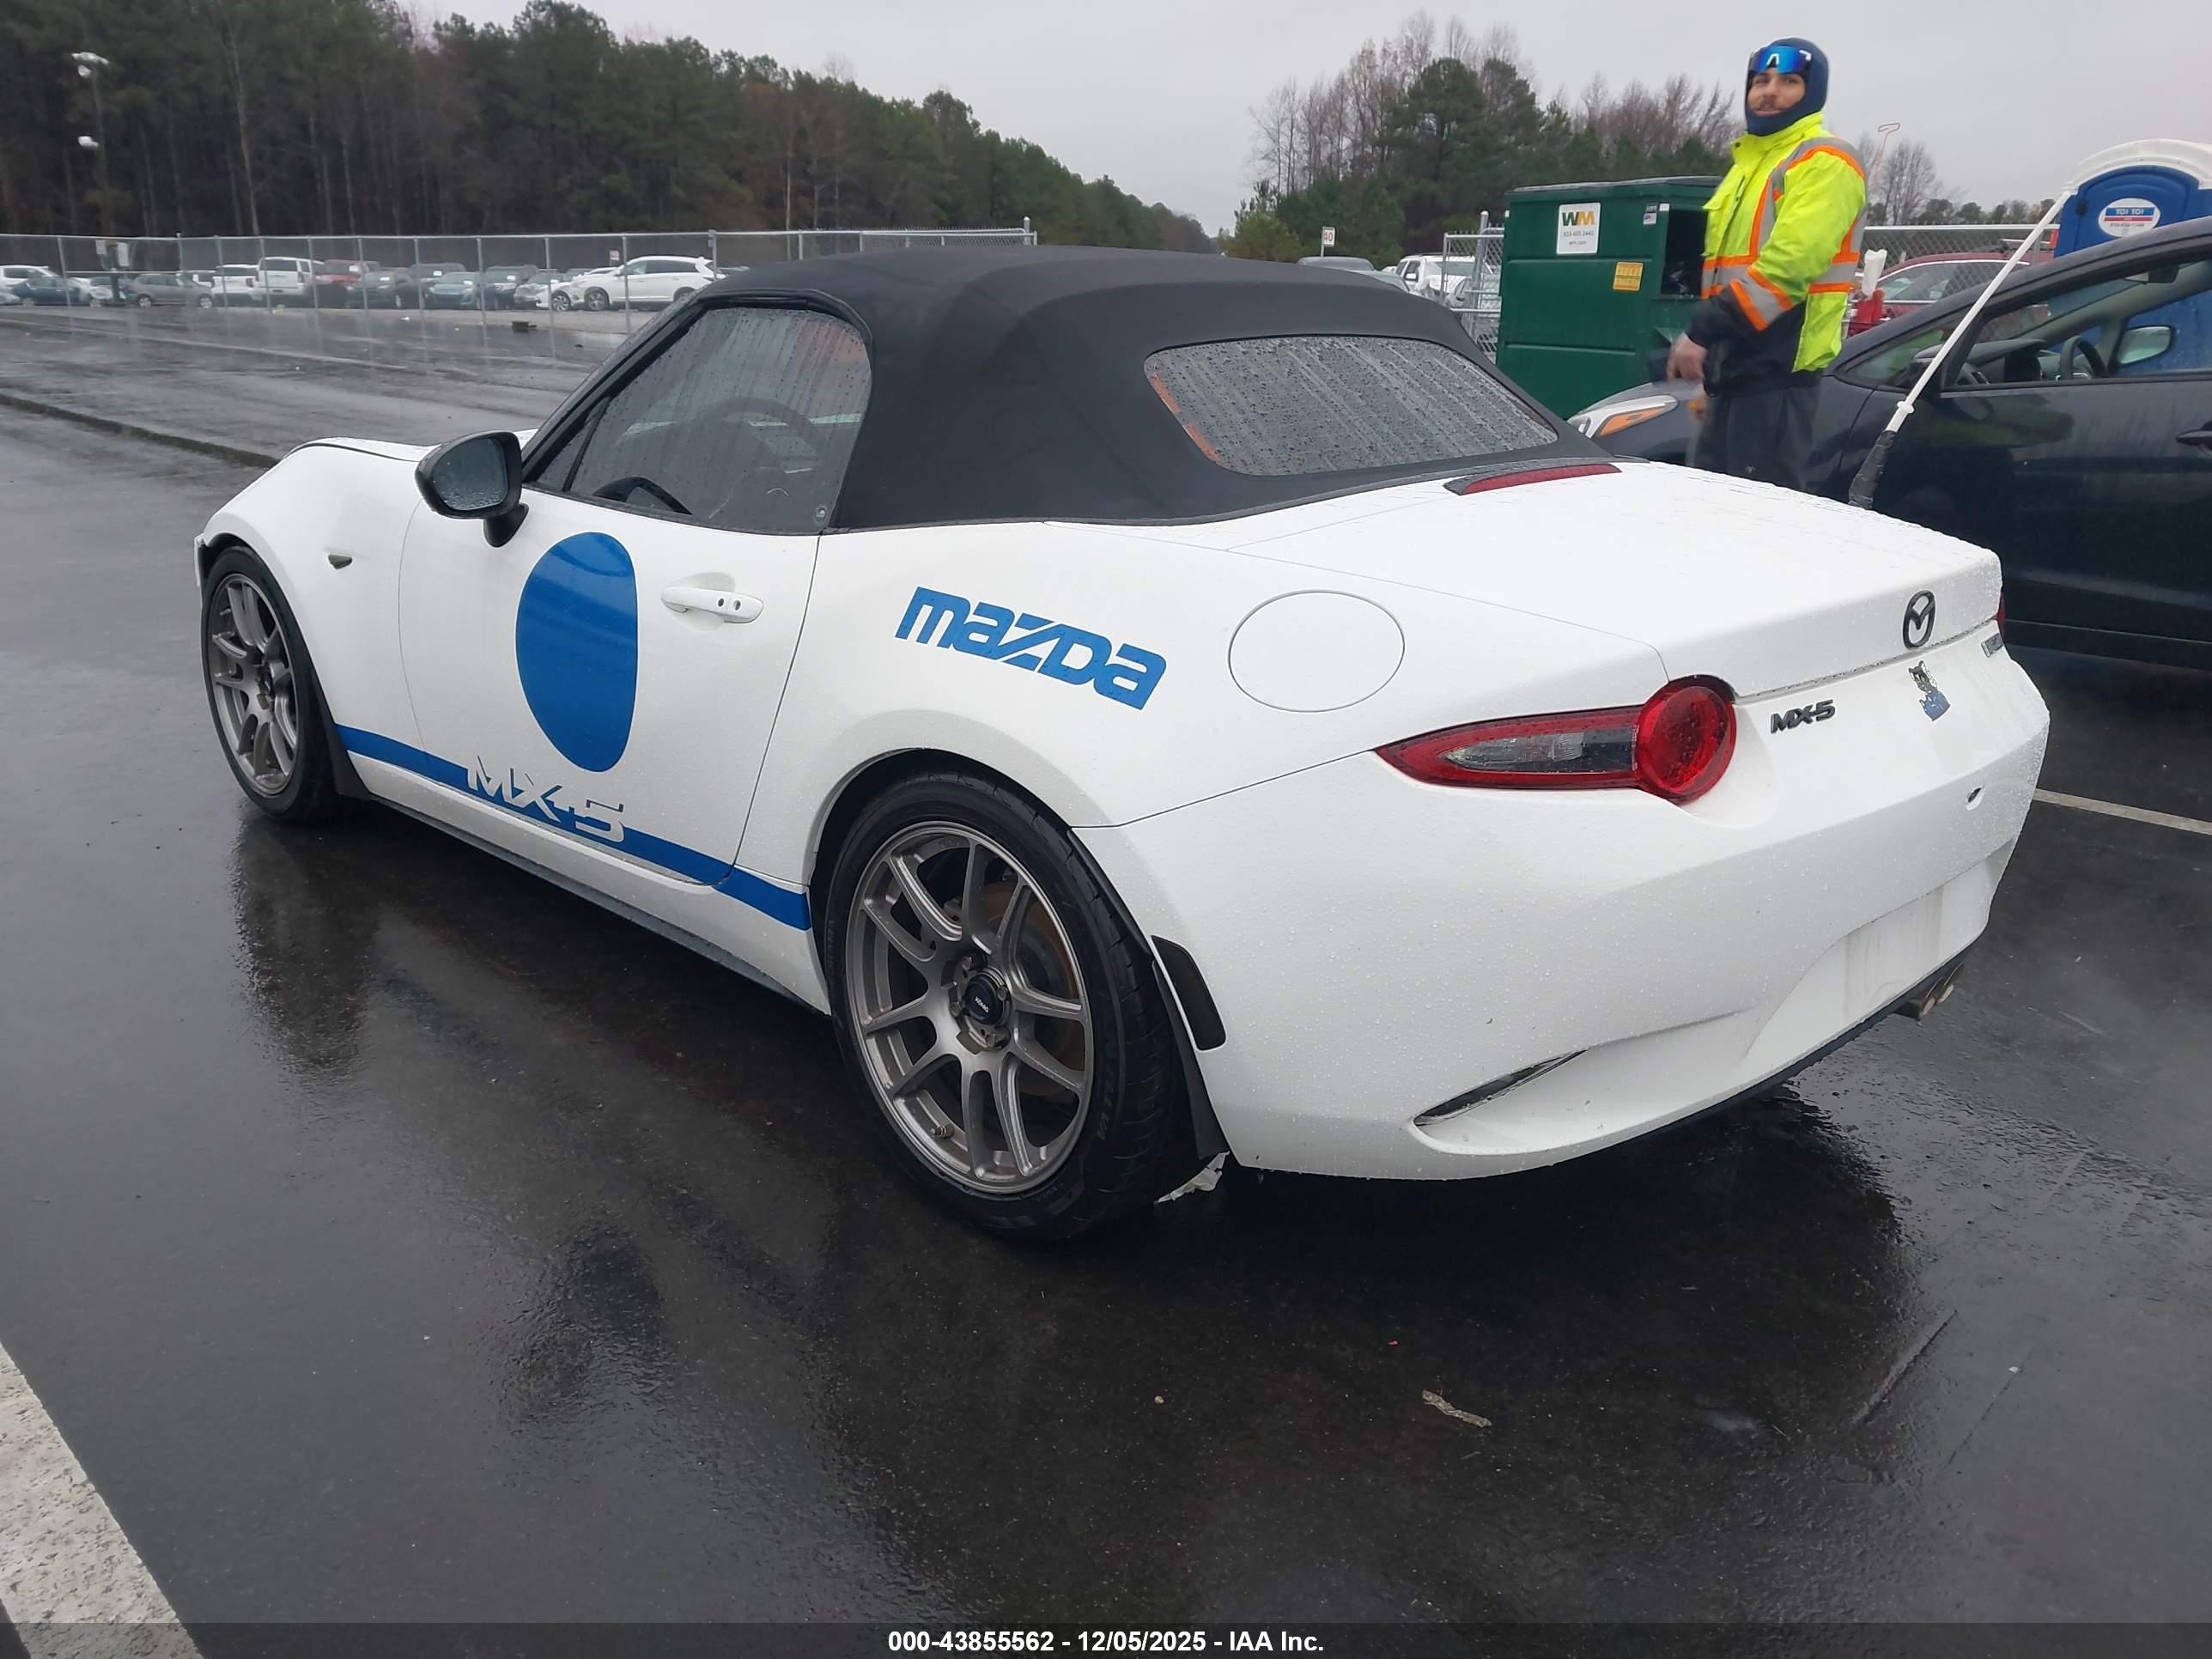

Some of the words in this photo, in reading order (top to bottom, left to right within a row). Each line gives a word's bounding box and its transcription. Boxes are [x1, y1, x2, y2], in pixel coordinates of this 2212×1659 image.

[1562, 210, 1595, 227] WM
[1771, 699, 1836, 734] MX-5
[467, 755, 624, 842] MX-5
